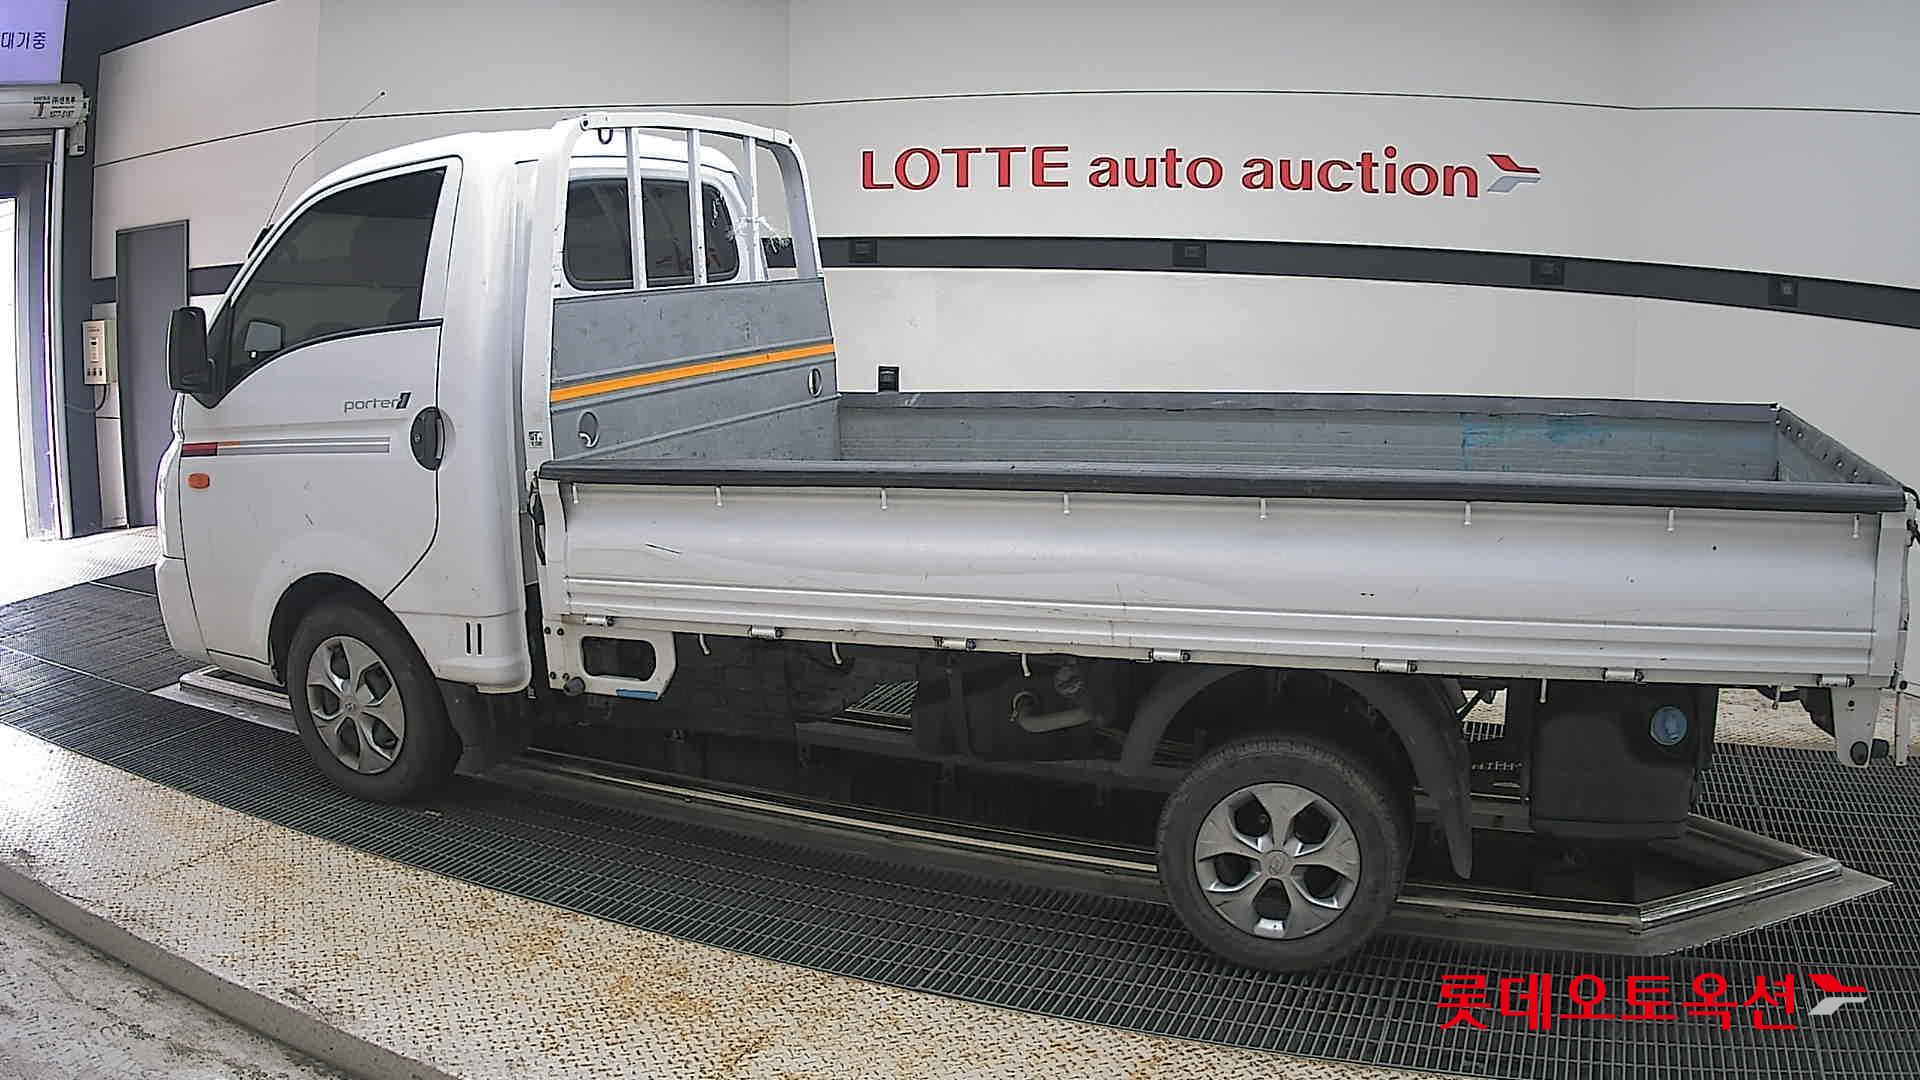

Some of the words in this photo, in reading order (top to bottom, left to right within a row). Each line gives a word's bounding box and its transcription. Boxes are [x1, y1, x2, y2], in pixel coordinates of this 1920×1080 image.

[1, 31, 46, 49] 대기중
[862, 145, 1069, 190] LOTTE
[1088, 148, 1224, 190] auto
[1241, 145, 1479, 197] auction
[344, 398, 399, 413] porter
